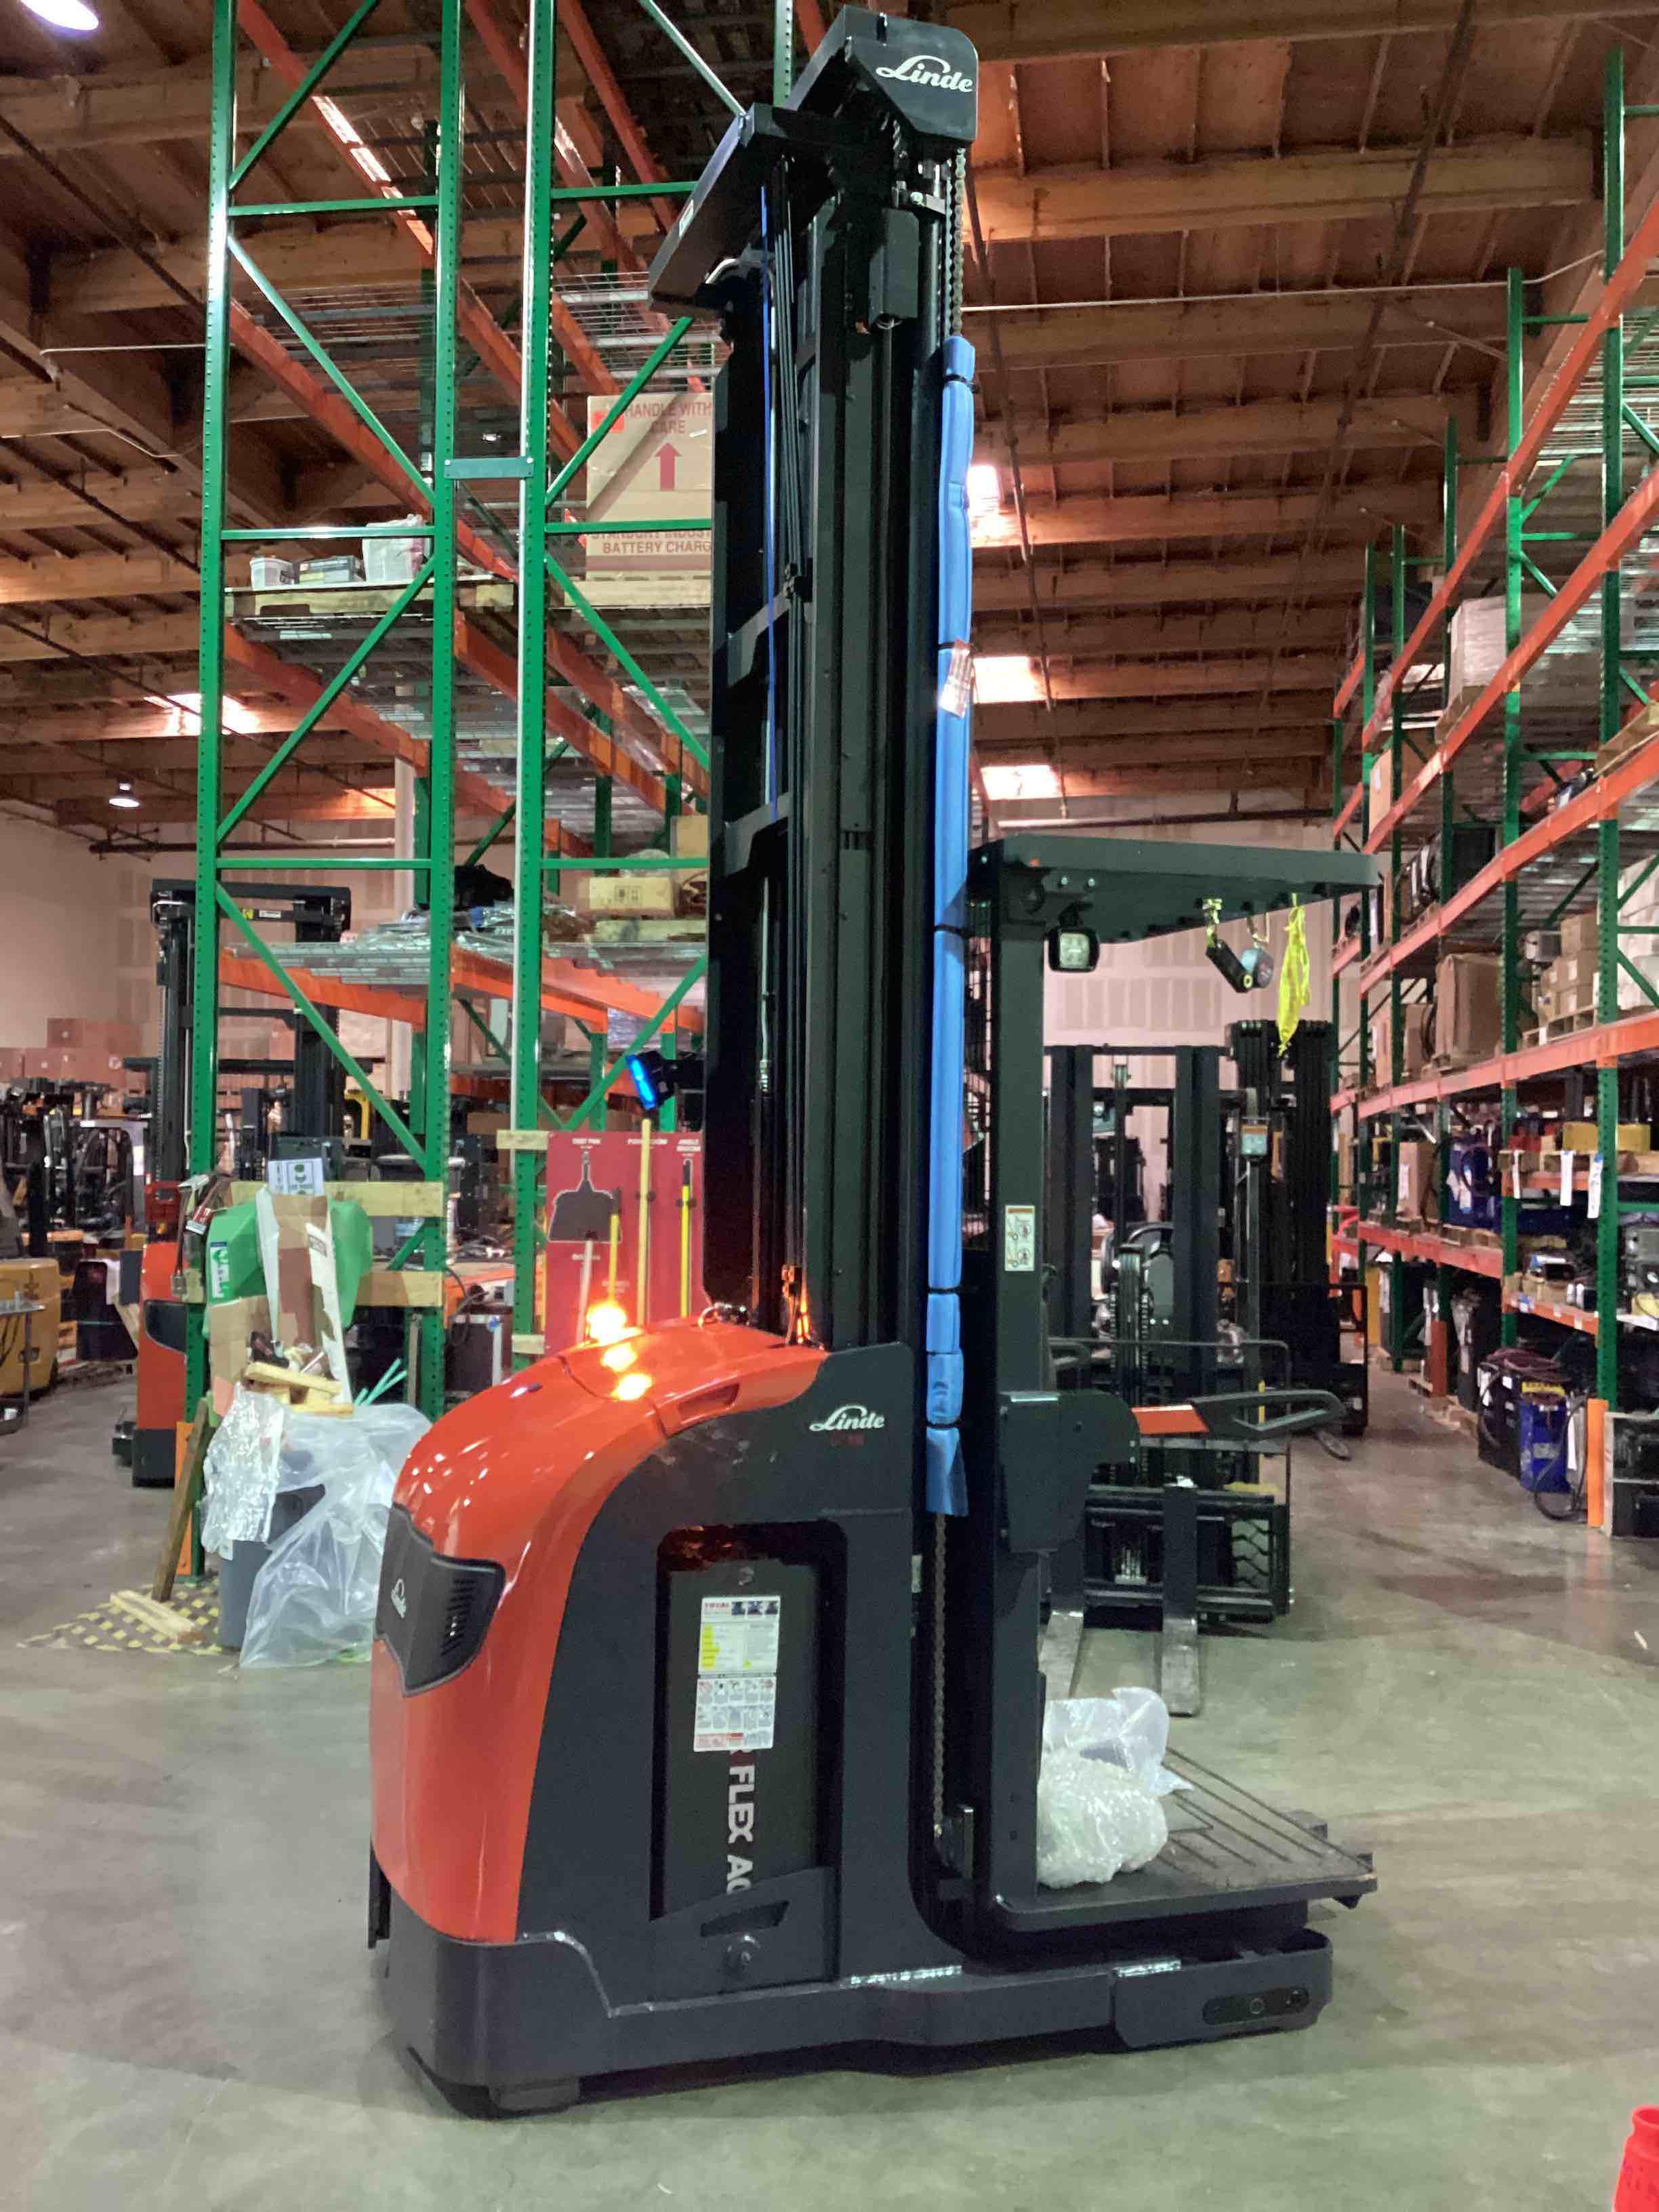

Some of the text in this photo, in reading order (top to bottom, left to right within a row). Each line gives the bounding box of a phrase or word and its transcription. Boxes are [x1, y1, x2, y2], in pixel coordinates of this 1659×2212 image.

[876, 55, 973, 93] Linde
[602, 541, 662, 554] BATTERY
[809, 1405, 885, 1431] Linde
[727, 1765, 756, 1843] FLEX
